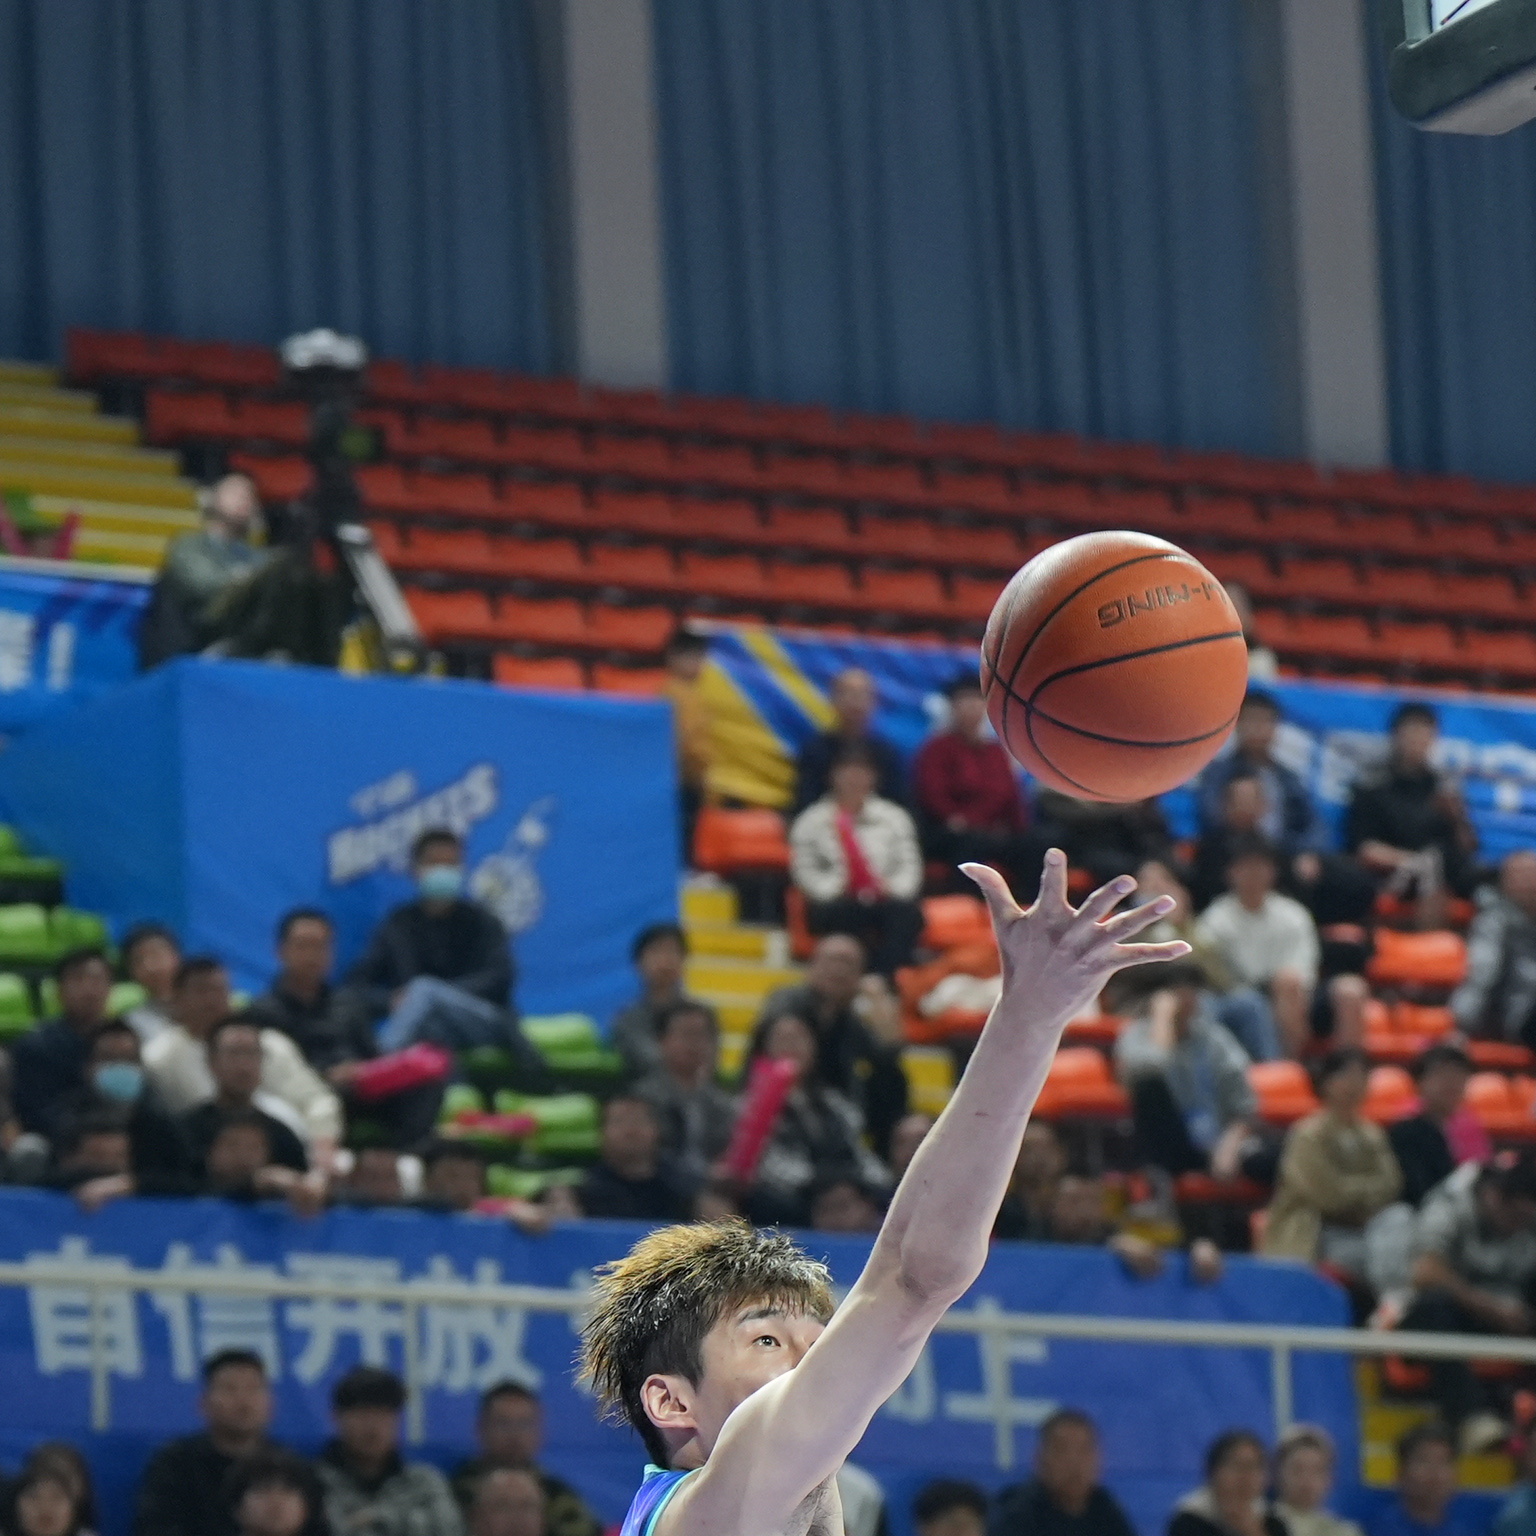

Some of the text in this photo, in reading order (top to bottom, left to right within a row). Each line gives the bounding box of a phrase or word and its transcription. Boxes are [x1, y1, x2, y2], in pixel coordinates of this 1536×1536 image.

[1097, 581, 1229, 629] LI-NING
[28, 1237, 543, 1393] 自信开放
